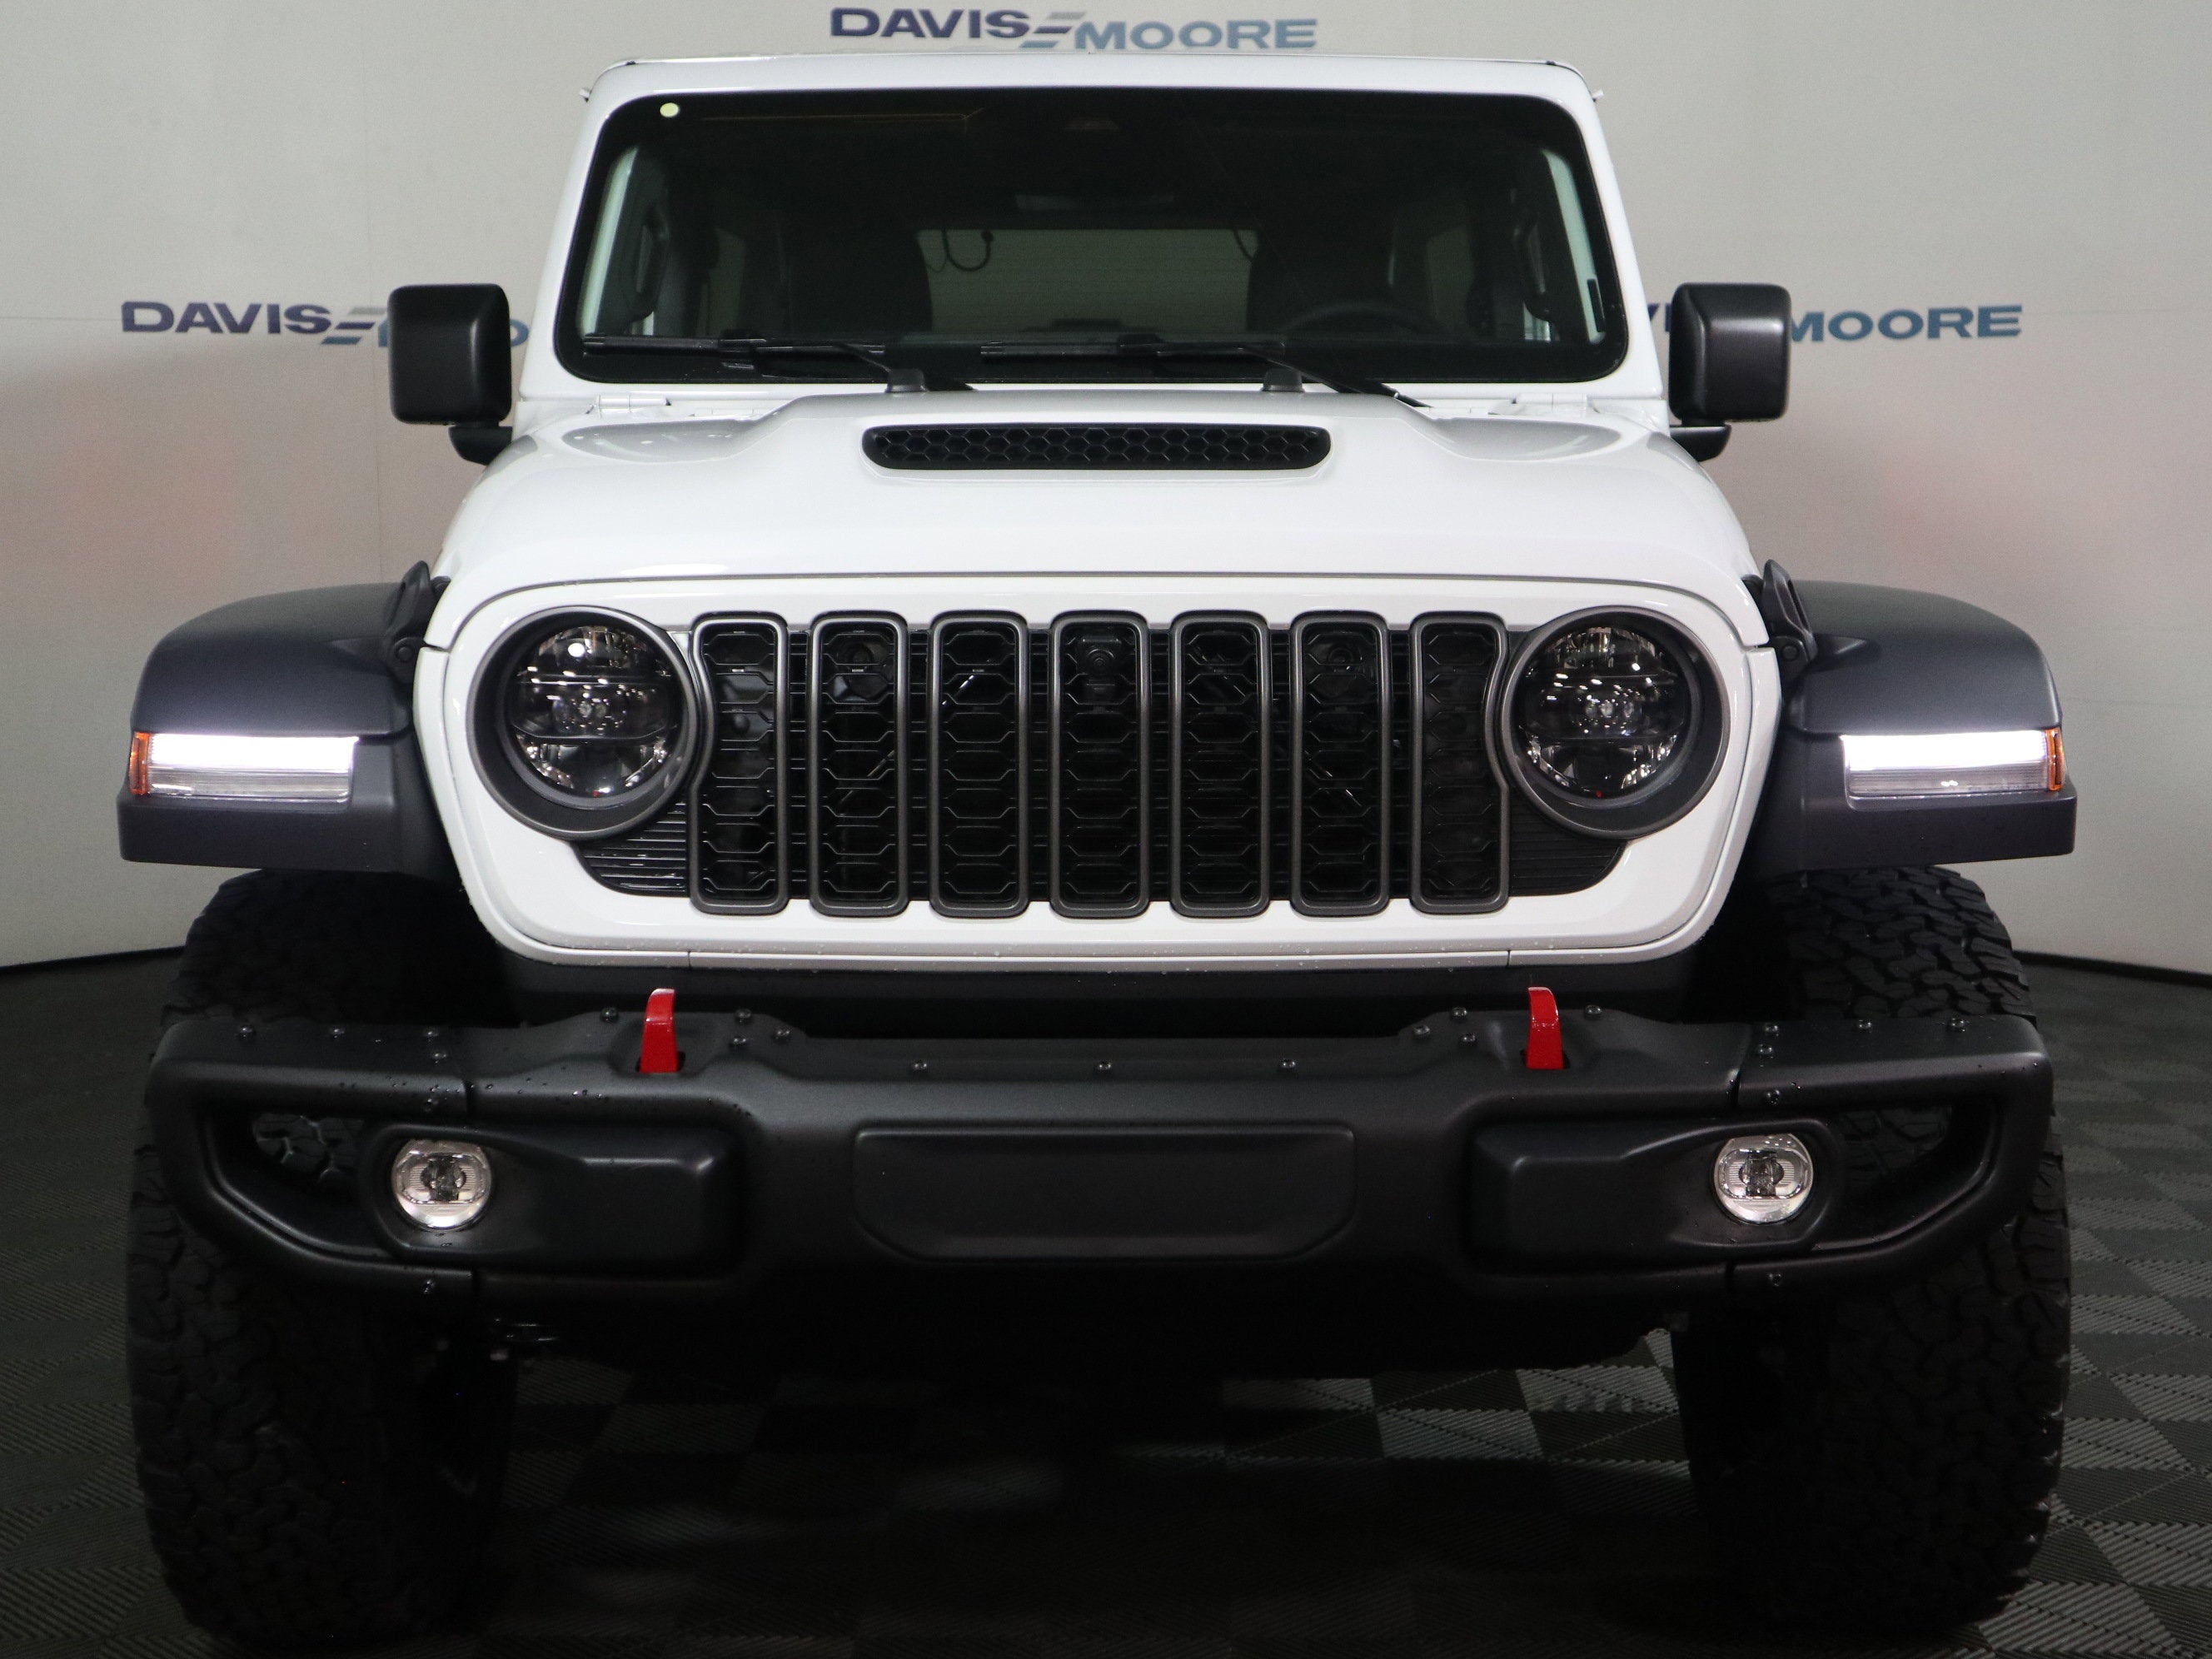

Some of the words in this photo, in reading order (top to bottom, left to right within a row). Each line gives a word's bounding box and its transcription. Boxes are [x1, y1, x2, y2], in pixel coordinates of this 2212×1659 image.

[830, 7, 1029, 39] DAVIS
[1074, 18, 1318, 50] MOORE
[121, 301, 331, 334] DAVIS
